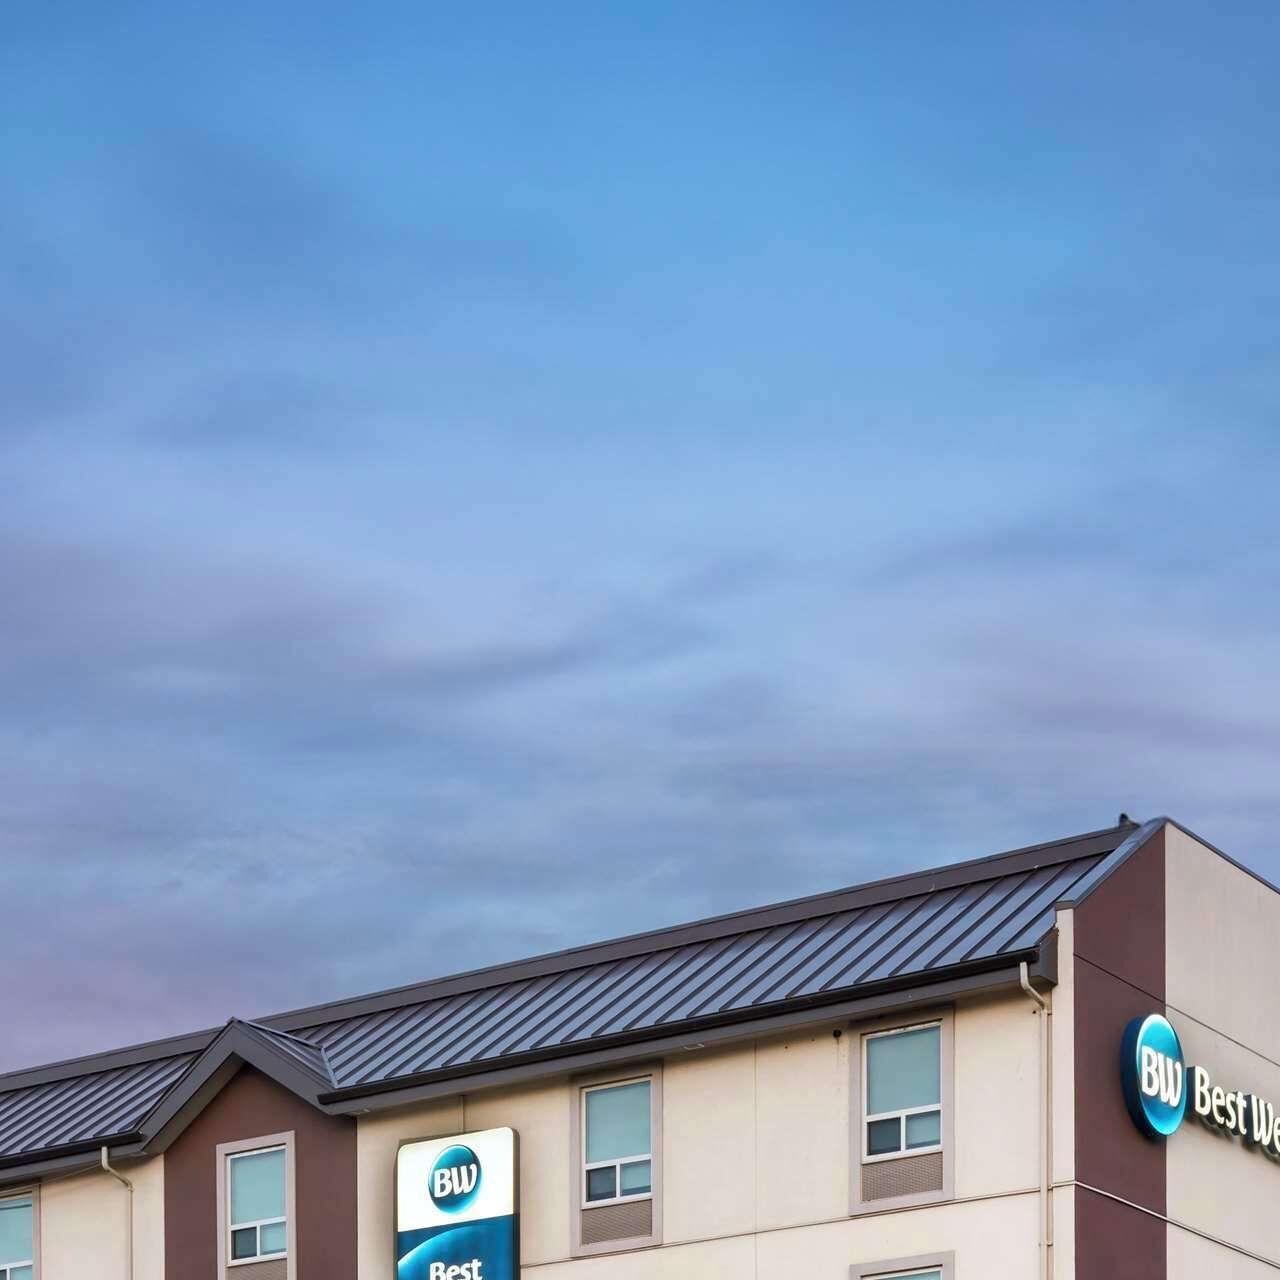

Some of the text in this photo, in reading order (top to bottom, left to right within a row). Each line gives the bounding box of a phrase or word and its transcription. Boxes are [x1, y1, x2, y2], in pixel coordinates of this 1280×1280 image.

[1141, 1045, 1183, 1108] BW
[1194, 1065, 1247, 1136] Best
[433, 1163, 478, 1198] BW
